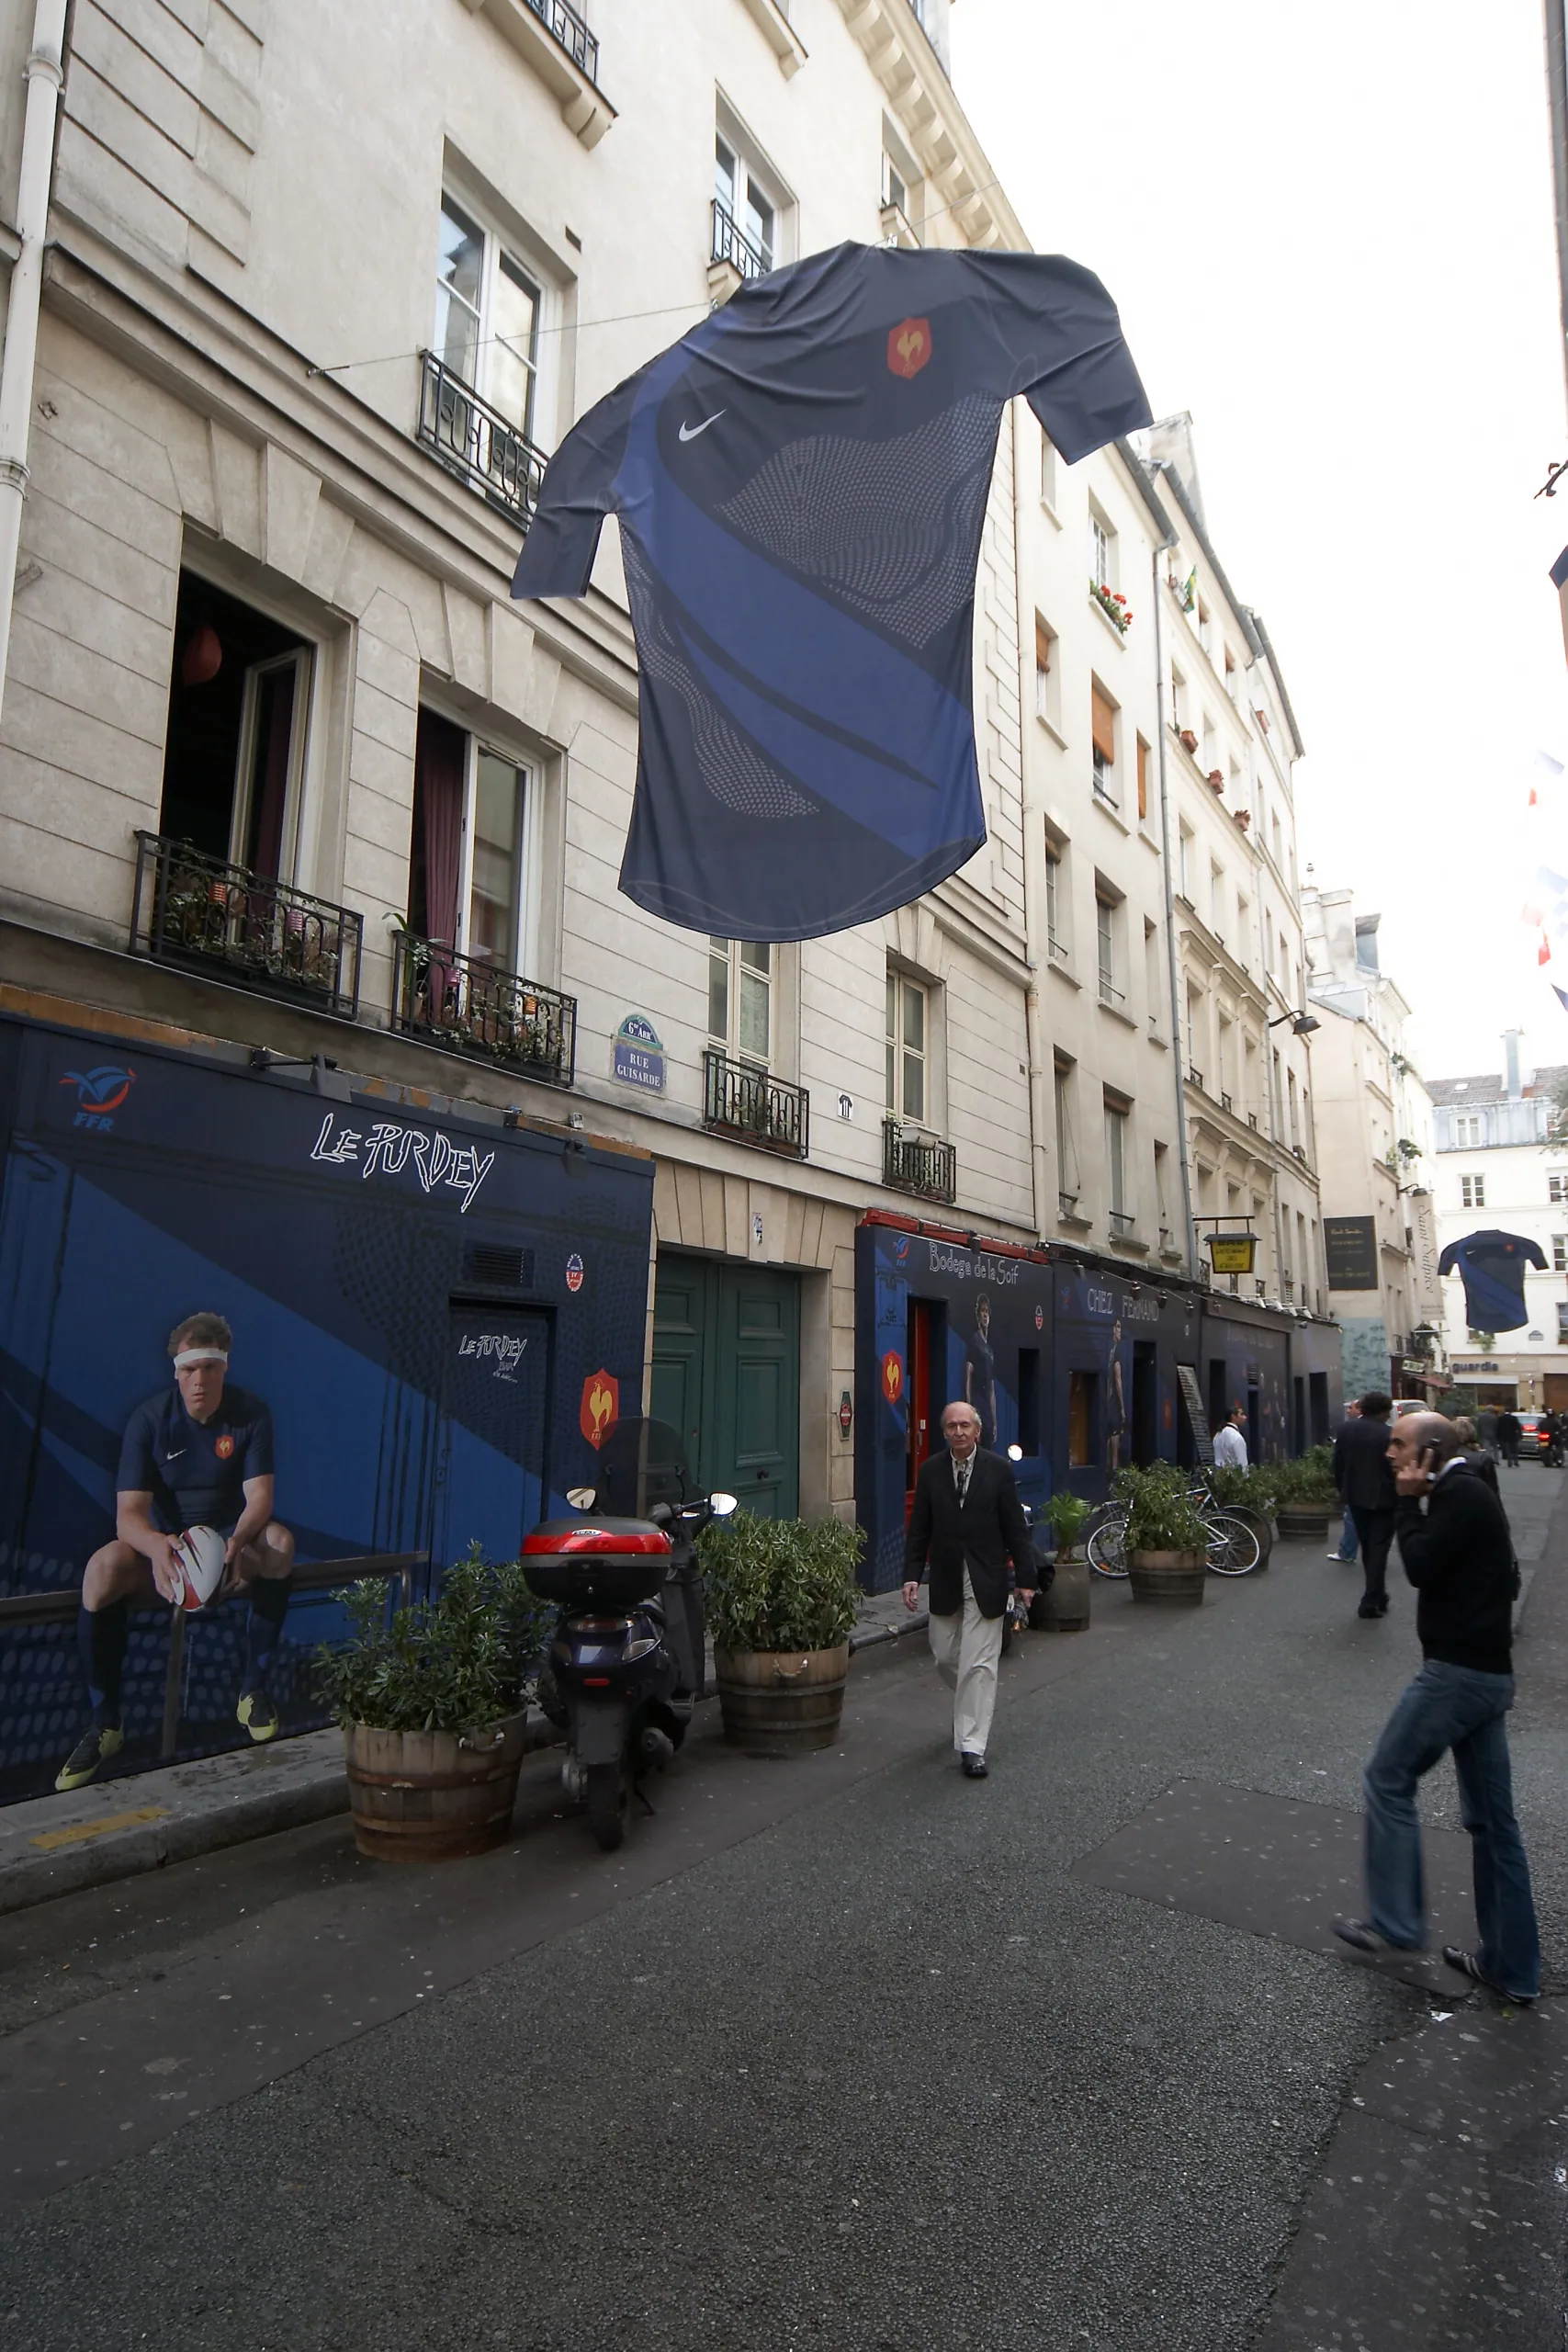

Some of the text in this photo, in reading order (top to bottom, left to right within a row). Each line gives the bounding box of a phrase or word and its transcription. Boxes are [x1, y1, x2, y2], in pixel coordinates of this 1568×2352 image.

[617, 1064, 660, 1087] GUISARDE
[630, 1053, 649, 1069] RUE
[73, 1112, 113, 1132] FFR
[310, 1113, 495, 1213] LE PURDEY
[1418, 1204, 1432, 1241] Saint
[929, 1241, 1019, 1285] Bodega de la Soif
[1087, 1288, 1160, 1322] CHEZ FERNAND
